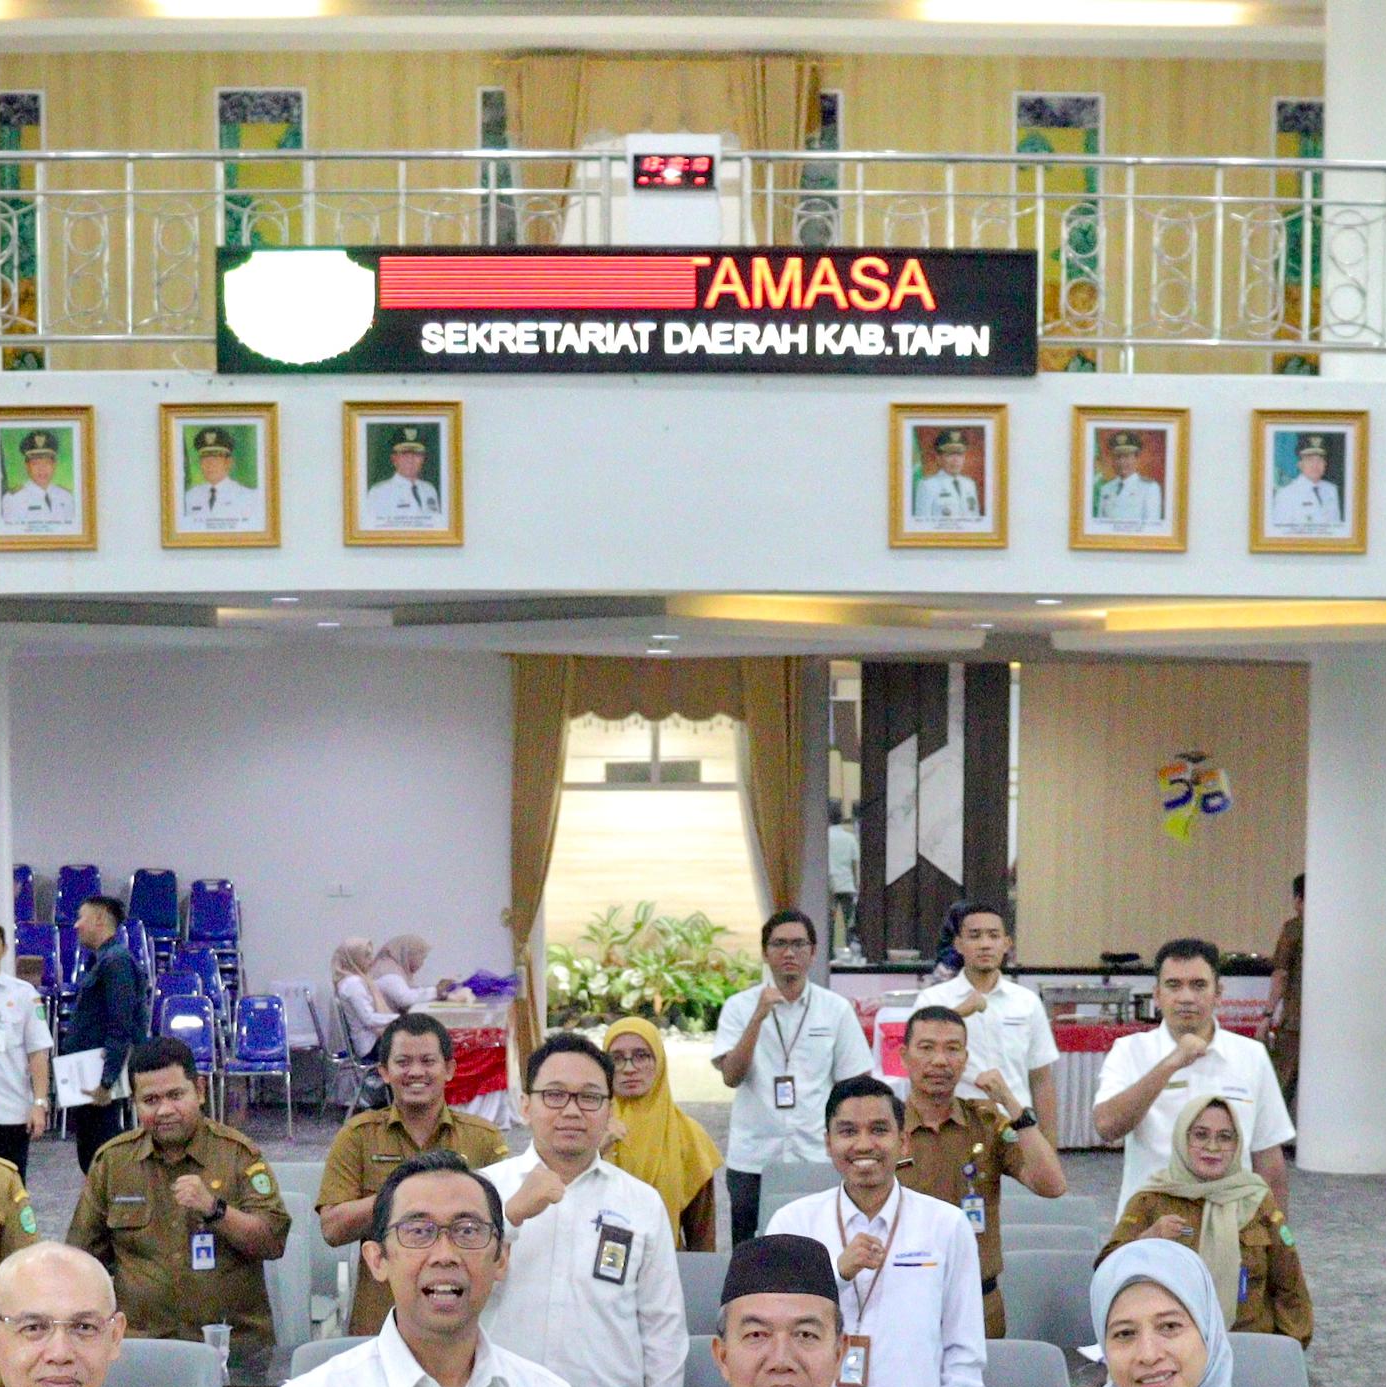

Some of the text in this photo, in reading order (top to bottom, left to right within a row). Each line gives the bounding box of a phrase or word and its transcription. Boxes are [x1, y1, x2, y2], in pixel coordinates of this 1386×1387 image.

[421, 322, 990, 356] SEKRETARIAT DAERAH KAB.TAPIN
